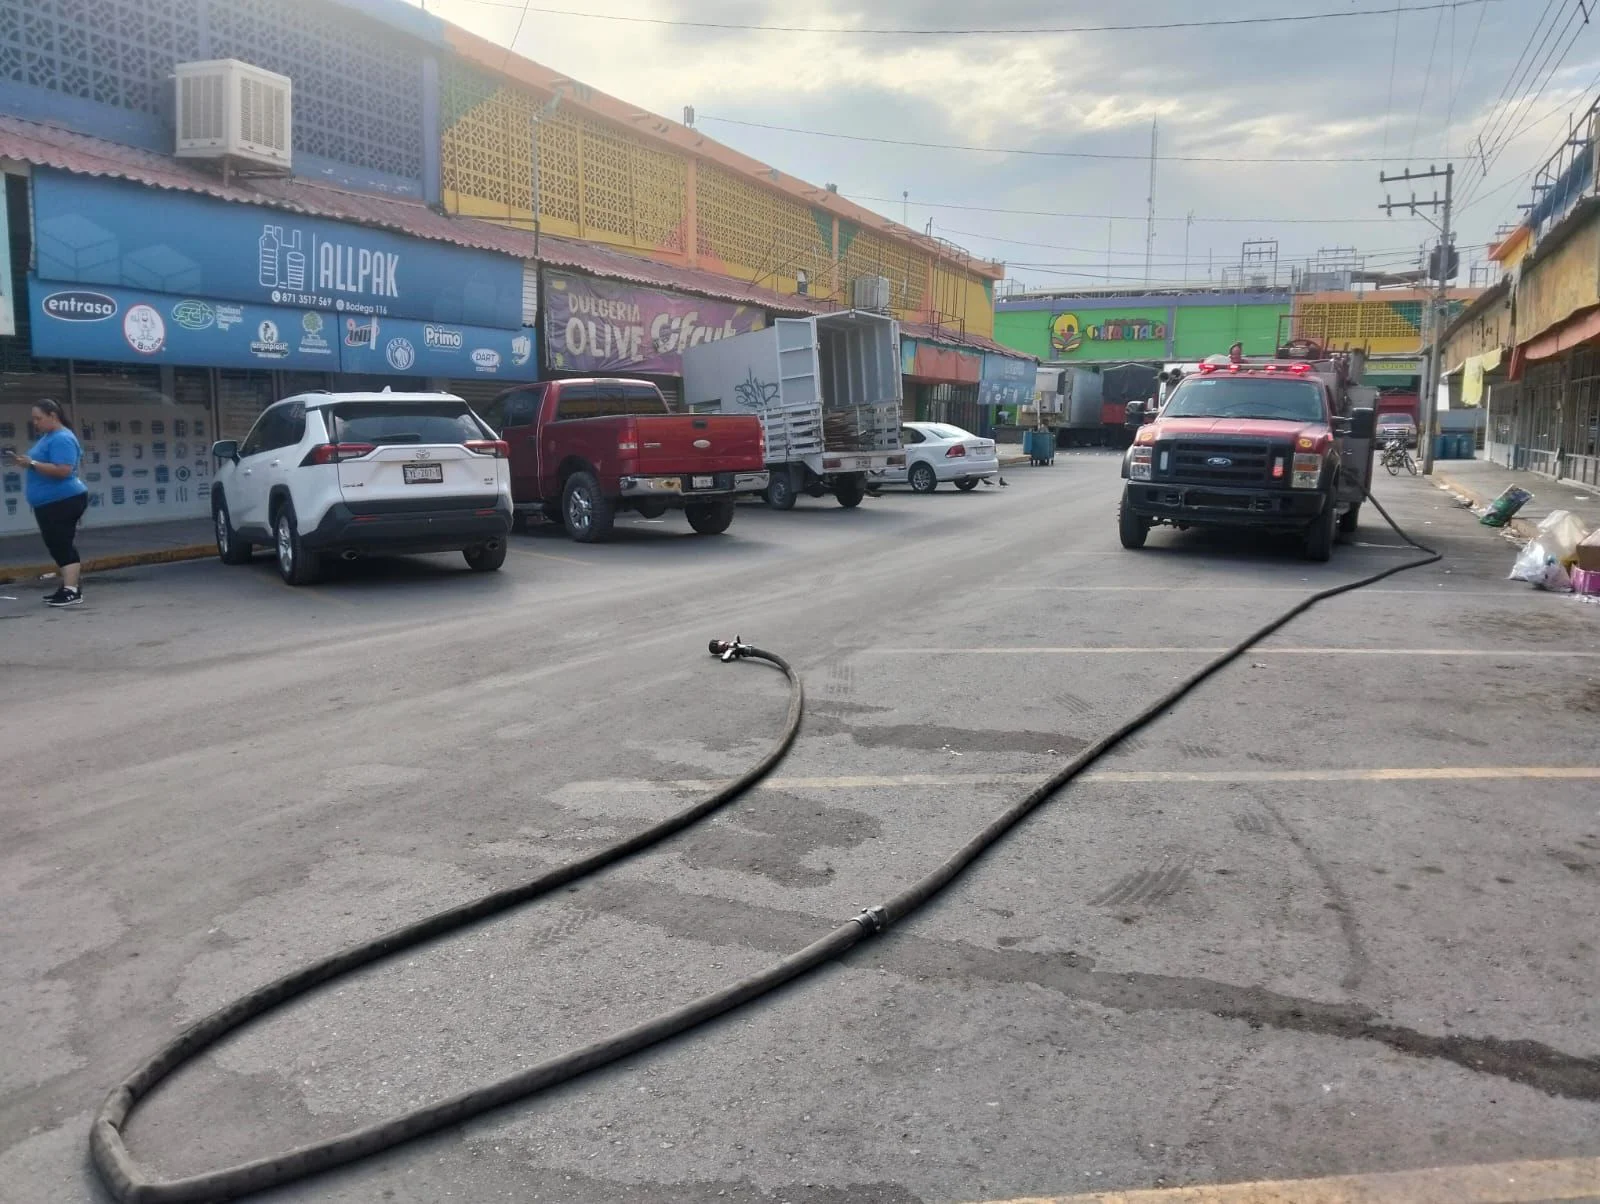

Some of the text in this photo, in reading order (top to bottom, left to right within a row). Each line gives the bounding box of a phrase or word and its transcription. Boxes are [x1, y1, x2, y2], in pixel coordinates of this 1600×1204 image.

[319, 241, 399, 298] ALLPAK
[48, 298, 112, 315] entrasa
[281, 292, 387, 315] 871 3517 569 Bodega 116
[568, 293, 641, 322] DULCERIA
[425, 327, 462, 347] Primo
[565, 317, 645, 362] OLIVE
[475, 352, 496, 362] DART
